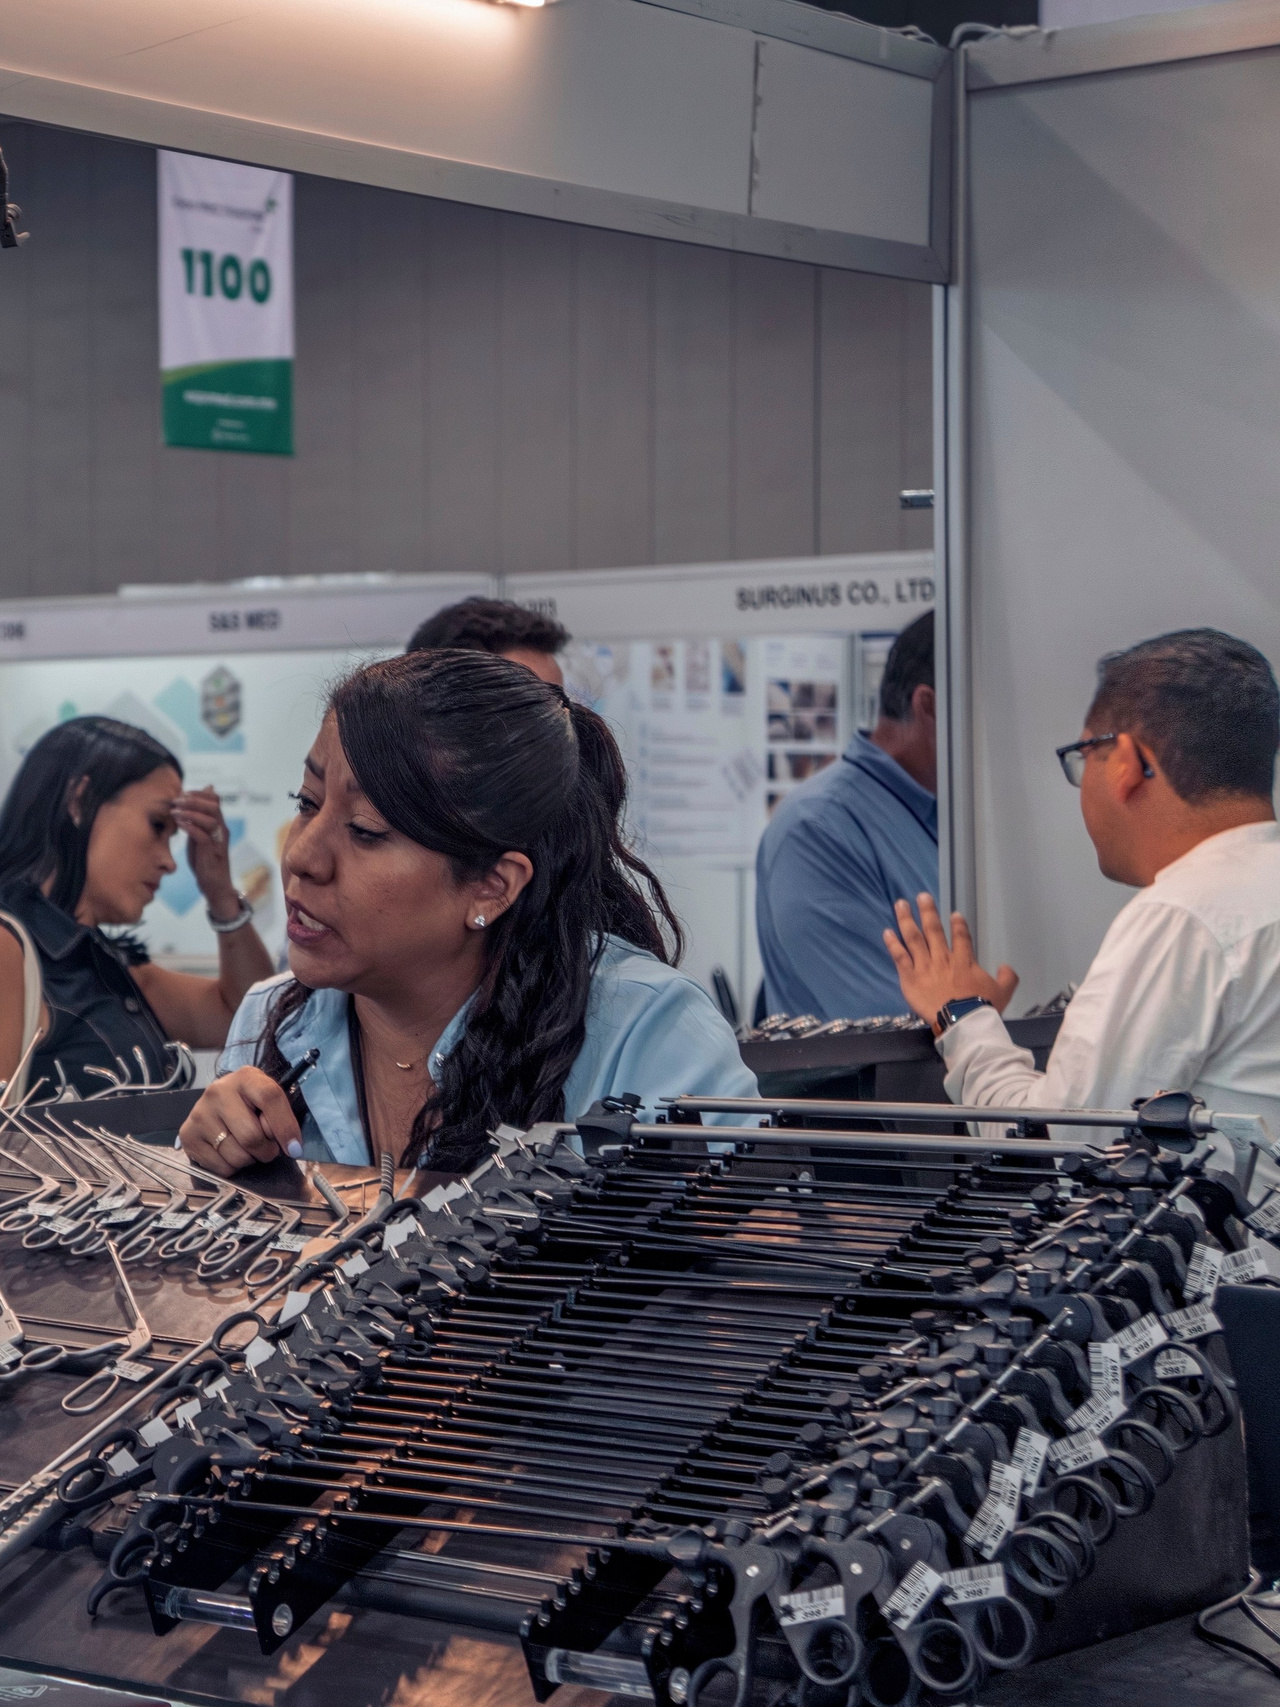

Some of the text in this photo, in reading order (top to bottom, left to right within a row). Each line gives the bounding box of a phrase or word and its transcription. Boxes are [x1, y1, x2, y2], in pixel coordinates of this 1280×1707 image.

[181, 246, 272, 305] 1100
[736, 581, 842, 611] SURGINUS
[894, 576, 936, 604] LTD
[1162, 1365, 1187, 1376] 3987
[1072, 1451, 1093, 1467] 3987
[963, 1586, 990, 1600] 3987
